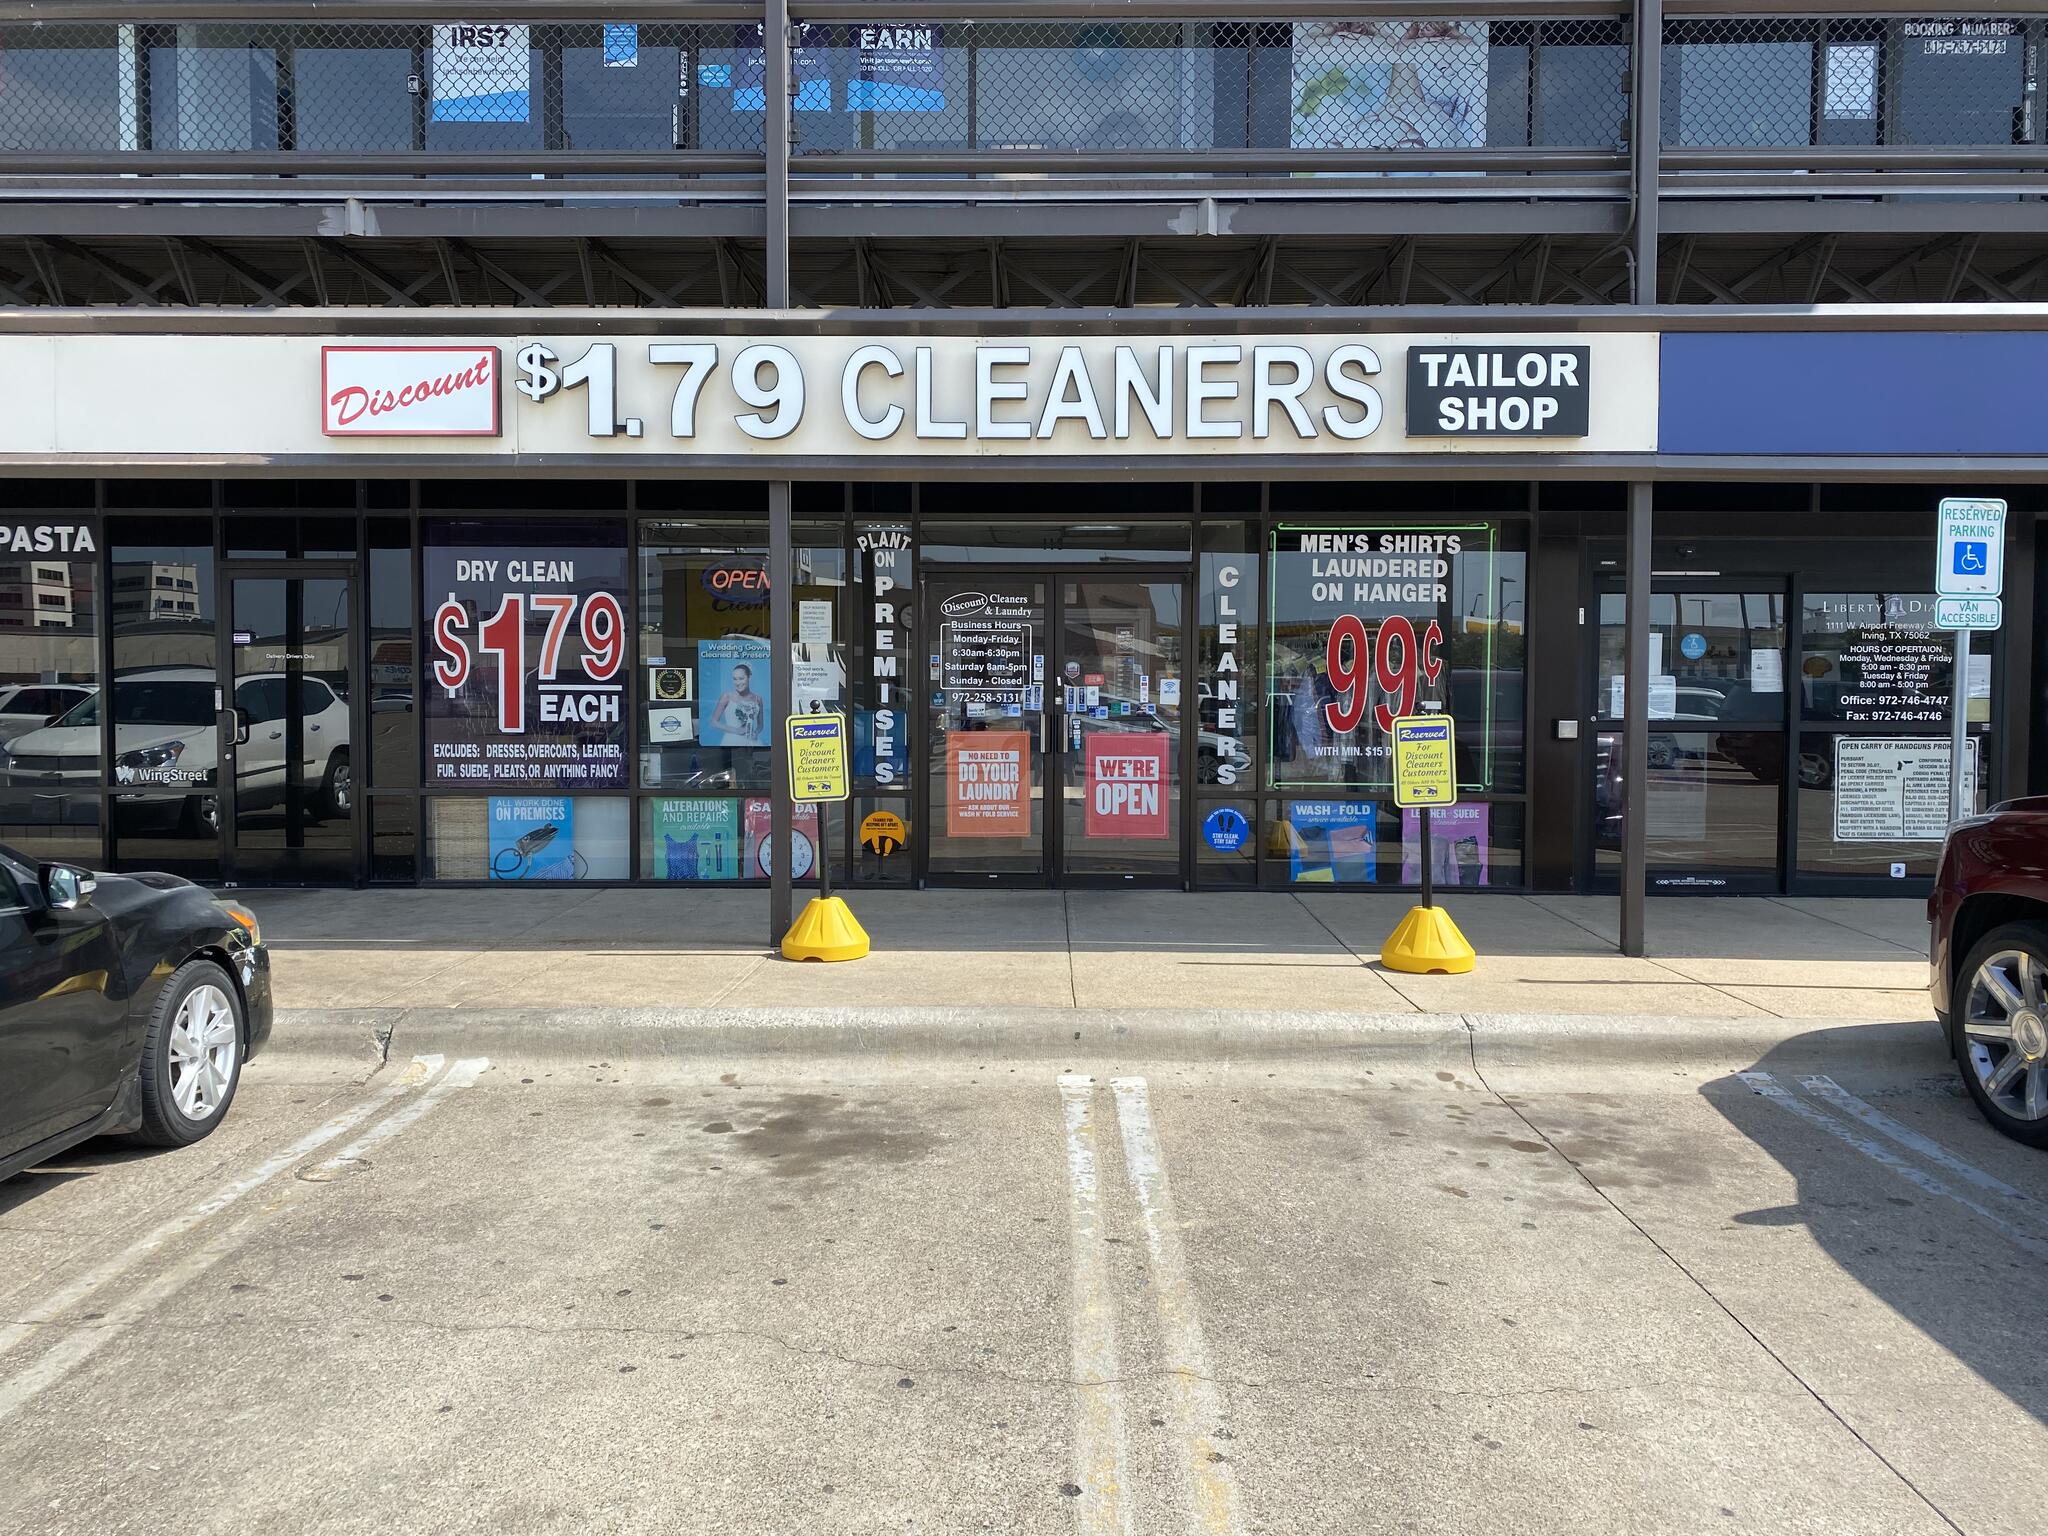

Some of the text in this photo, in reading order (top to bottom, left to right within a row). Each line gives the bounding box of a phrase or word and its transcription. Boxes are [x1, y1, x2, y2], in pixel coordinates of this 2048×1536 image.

[1904, 22, 2015, 36] BOOKING NUMBER:
[451, 26, 510, 48] IRS?
[860, 29, 932, 50] EARN
[1420, 354, 1579, 387] TAILOR
[331, 343, 1384, 439] Discount $1.79 CLEANERS
[1437, 397, 1560, 431] SHOP
[1945, 507, 2001, 521] RESERVED
[1949, 525, 1995, 538] PARKING
[0, 525, 96, 553] PASTA
[856, 530, 913, 552] PLANT
[1300, 534, 1461, 554] MEN'S SHIRTS
[875, 551, 895, 567] ON
[457, 560, 574, 582] DRY CLEAN
[1312, 558, 1448, 578] LAUNDERED
[712, 569, 771, 589] OPEN
[990, 594, 1028, 603] Cleaners
[1311, 583, 1447, 602] ON HANGER
[944, 596, 985, 613] Discount
[1823, 601, 1883, 613] LIBERTY
[1959, 603, 1979, 613] VAN
[984, 606, 1032, 618] & Laundry
[1940, 613, 1997, 623] ACCESSIBLE
[951, 621, 1021, 629] Business Hours
[1826, 622, 1844, 630] 1111
[1859, 622, 1887, 631] Airport
[1889, 622, 1925, 631] Freeway
[953, 635, 1019, 644] Monday-Friday
[1861, 632, 1887, 641] Irving,
[1904, 632, 1930, 640] 75062
[708, 643, 743, 652] Wedding
[952, 649, 1020, 658] 6:30am-6:30pm
[1874, 655, 1919, 663] Wednesday
[1929, 655, 1952, 663] Friday
[944, 663, 1028, 672] Saturday 8am-5pm
[873, 576, 897, 784] PREMISES
[949, 677, 1022, 686] Sunday Closed
[1217, 566, 1240, 785] CLEANERS
[1863, 672, 1895, 681] Tuesday
[1904, 672, 1928, 681] Friday
[1915, 682, 1929, 690] pm
[952, 693, 1020, 703] 972-258-5131
[1840, 695, 1949, 705] Office: 972-746-4747
[540, 694, 619, 723] EACH
[1846, 711, 1942, 720] Fax: 972-746-4746
[794, 726, 838, 737] Reserved
[1400, 729, 1446, 740] Reserved
[810, 740, 824, 748] For
[1416, 742, 1431, 751] For
[433, 743, 480, 758] EXCLUDES:
[582, 744, 622, 760] LEATHER,
[799, 748, 835, 757] Discount
[968, 752, 1010, 760] NO NEED TO
[1314, 745, 1383, 757] WITH MIN. $15
[1405, 751, 1443, 760] Discount
[800, 756, 836, 765] Cleaners
[1406, 760, 1442, 768] Cleaners
[459, 764, 491, 780] SUEDE,
[544, 764, 588, 778] ANYTHING
[590, 764, 619, 778] FANCY
[797, 765, 840, 774] Customers
[959, 763, 1019, 782] DO YOUR
[1099, 760, 1155, 778] WE'RE
[1402, 768, 1447, 778] Customers
[138, 767, 208, 784] WingStreet
[959, 783, 1019, 801] LAUNDRY
[1095, 783, 1159, 816] OPEN
[663, 801, 729, 813] ALTERATIONS
[1296, 805, 1371, 815] WASH FOLD
[496, 807, 565, 820] ON PREMISES
[663, 812, 729, 822] AND REPAIRS
[1411, 808, 1480, 819] LEHER SUEDE
